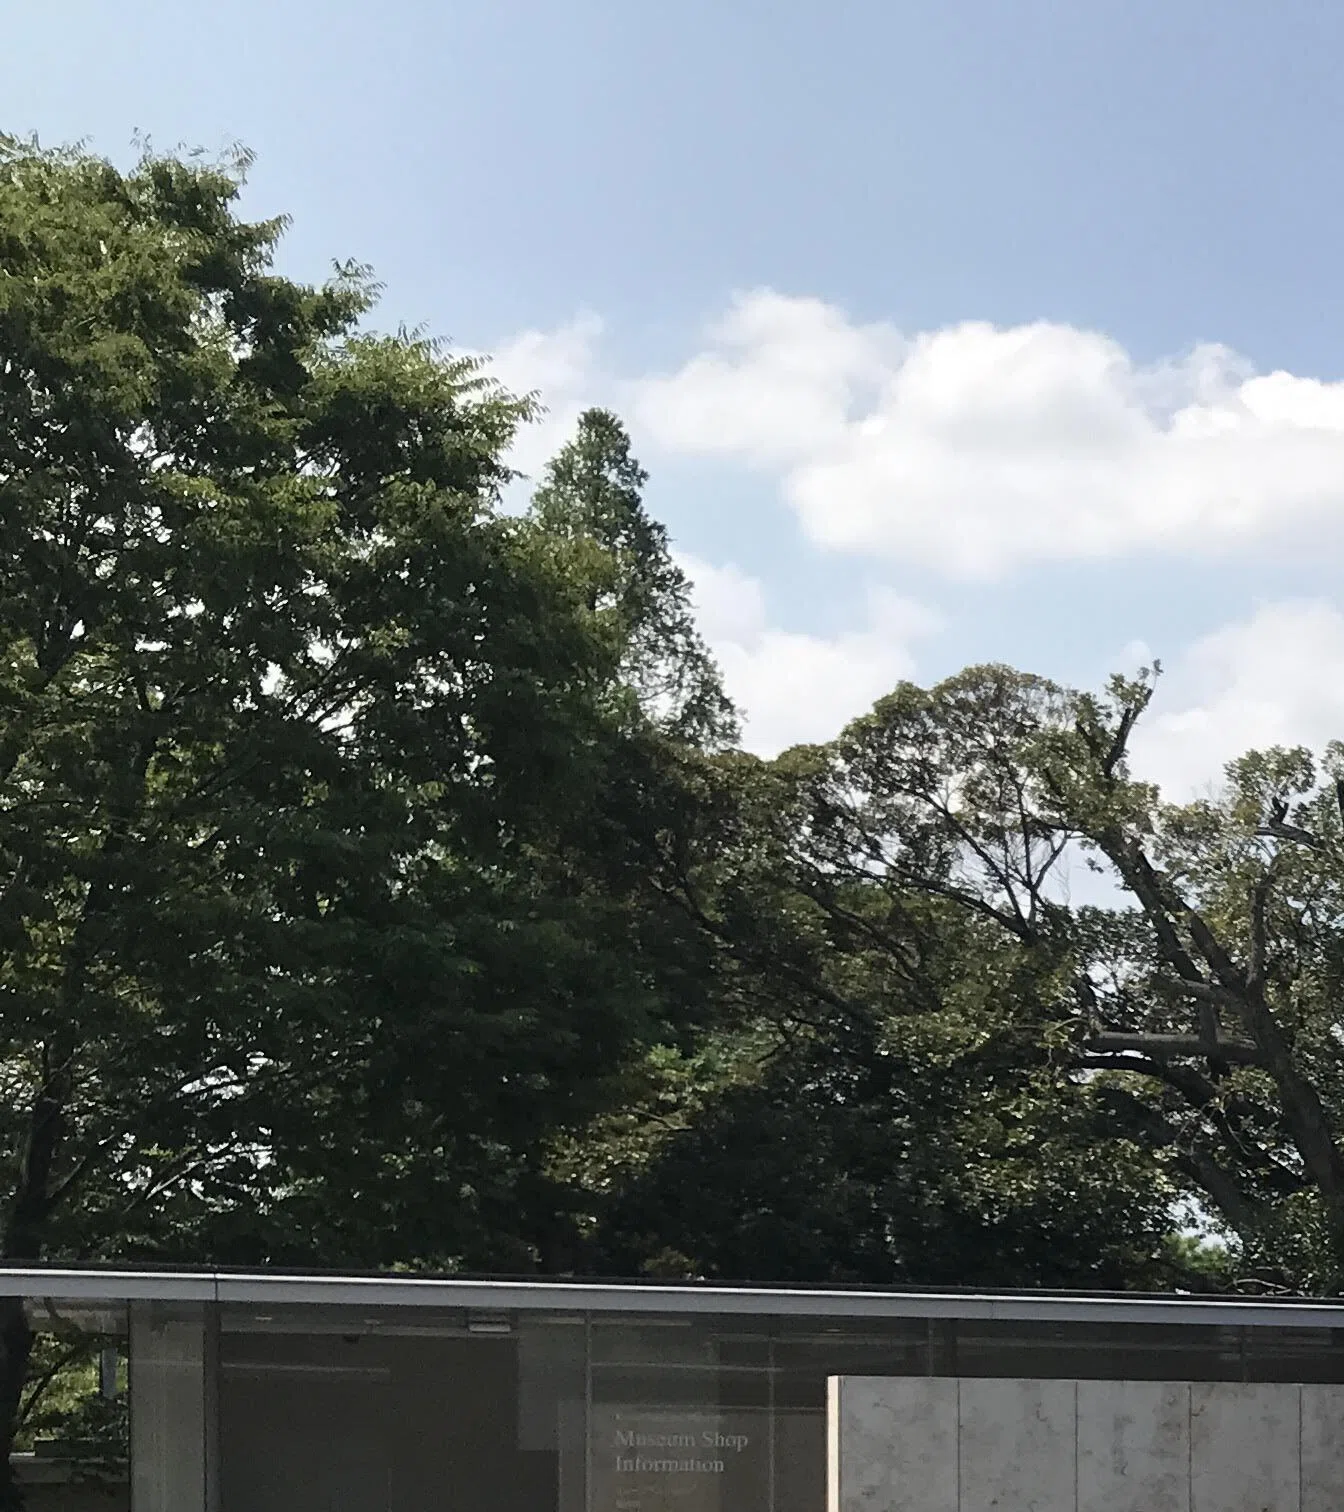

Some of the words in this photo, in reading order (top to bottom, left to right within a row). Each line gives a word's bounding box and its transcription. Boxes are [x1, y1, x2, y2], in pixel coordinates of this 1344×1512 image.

[614, 1430, 696, 1447] Museum
[702, 1431, 749, 1452] Shop
[615, 1455, 725, 1472] Information
